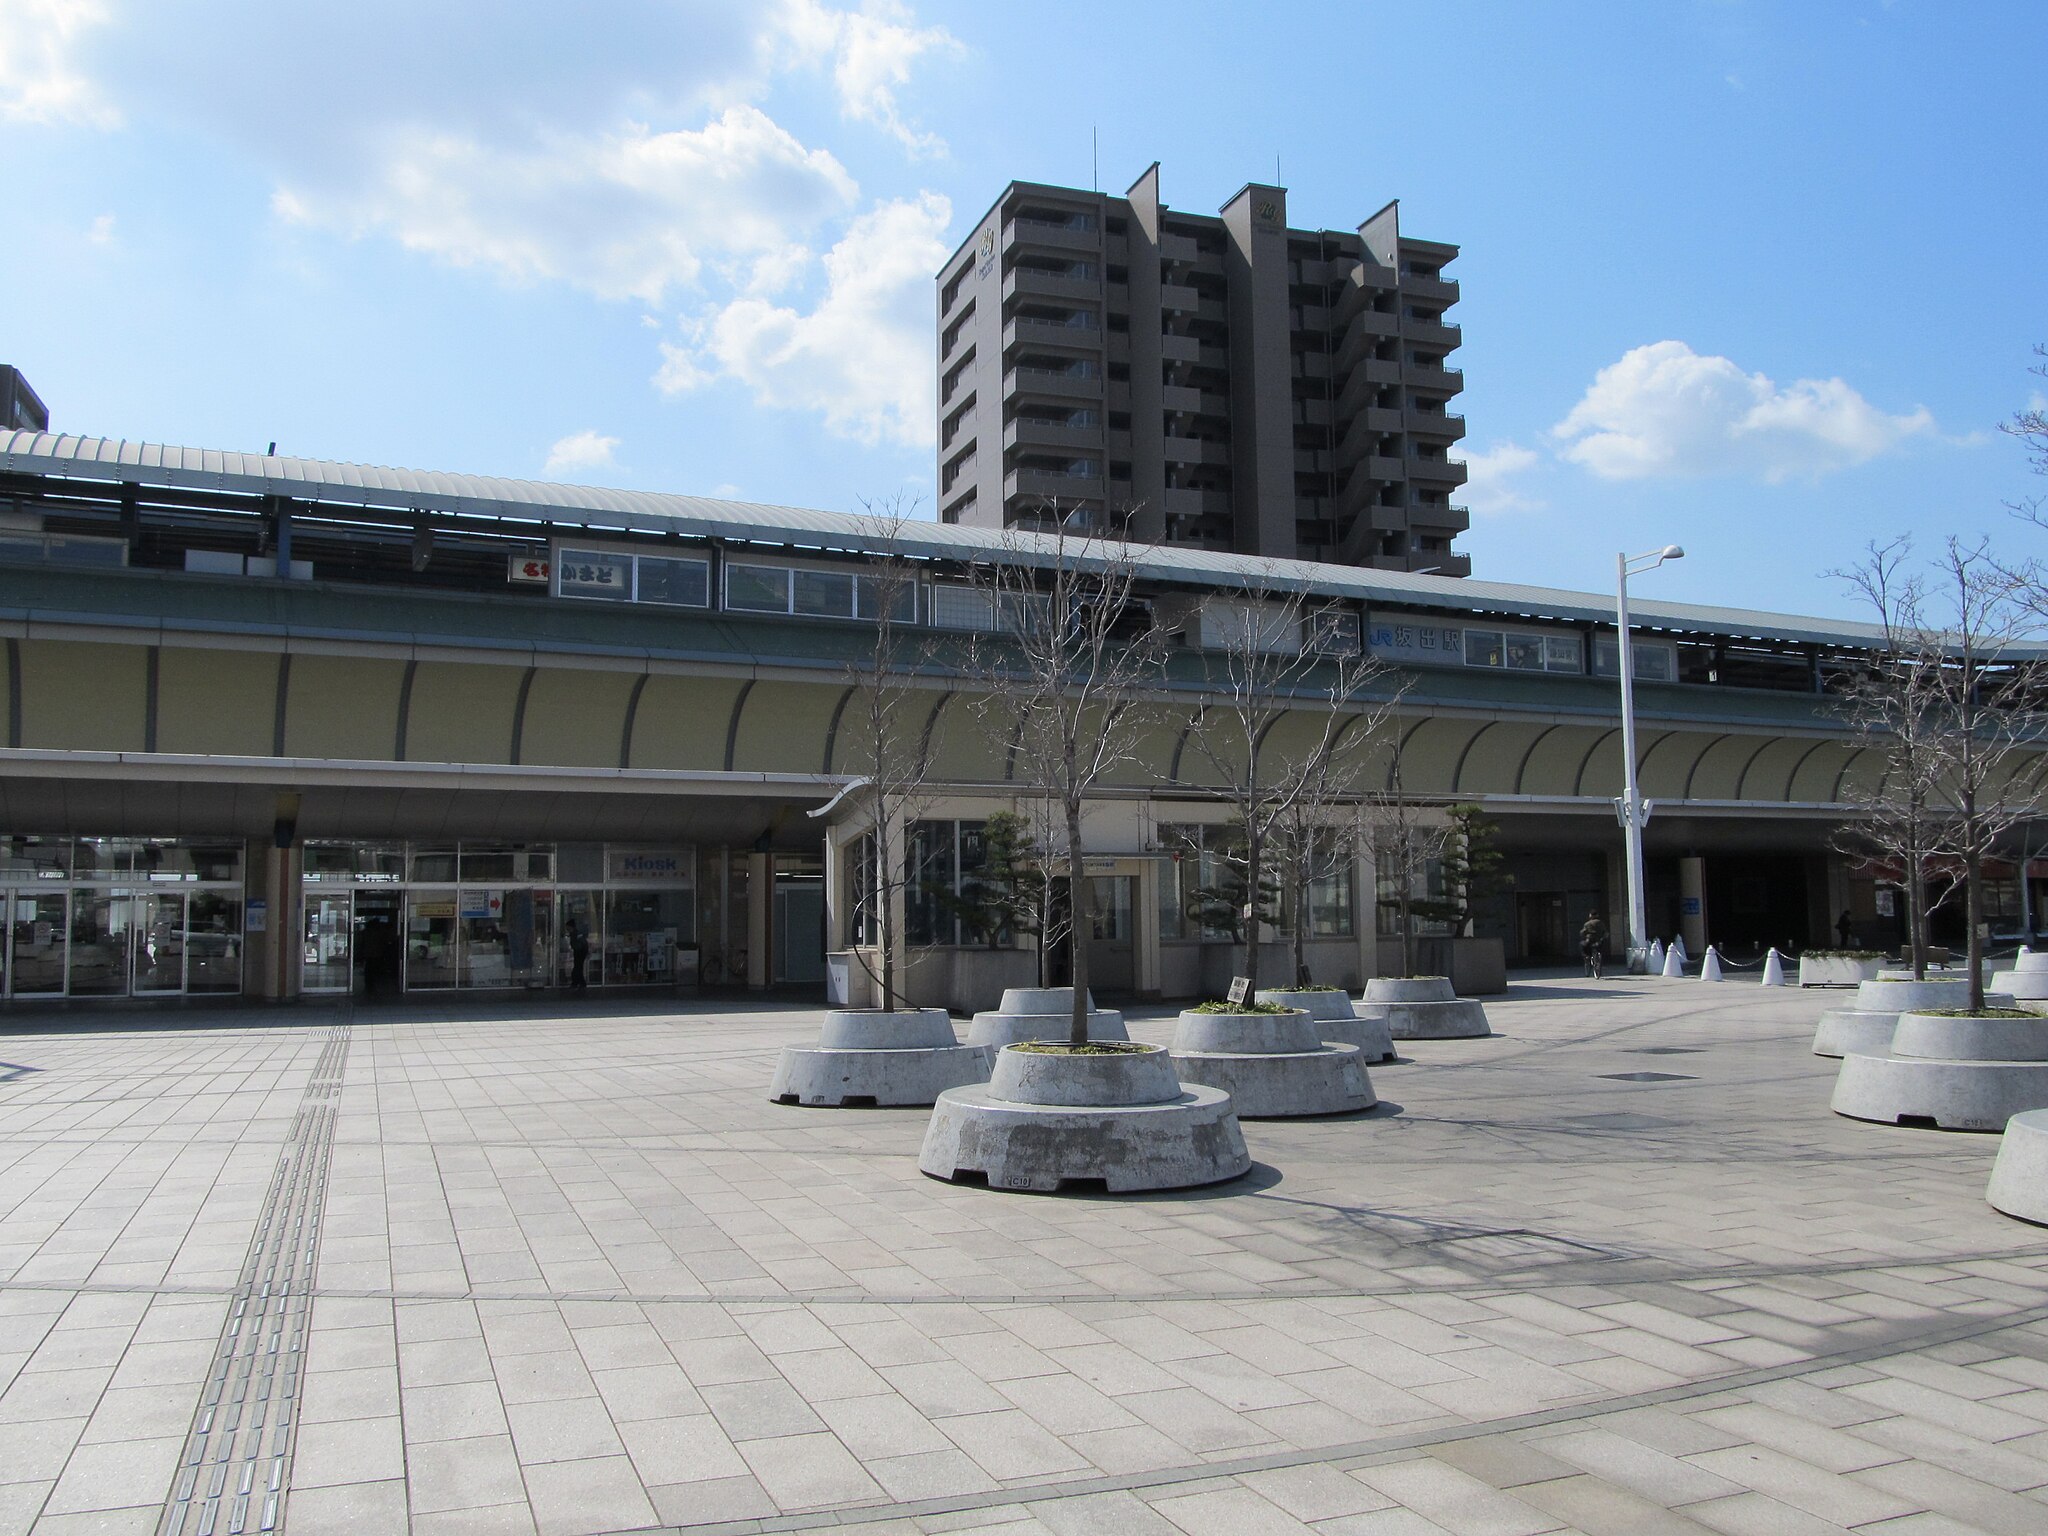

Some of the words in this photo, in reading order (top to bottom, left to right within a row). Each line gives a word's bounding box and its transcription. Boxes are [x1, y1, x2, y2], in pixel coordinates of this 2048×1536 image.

[561, 563, 613, 584] かまど
[1369, 629, 1393, 648] JR
[1395, 625, 1460, 652] 坂出駅
[624, 856, 676, 871] Kiosk
